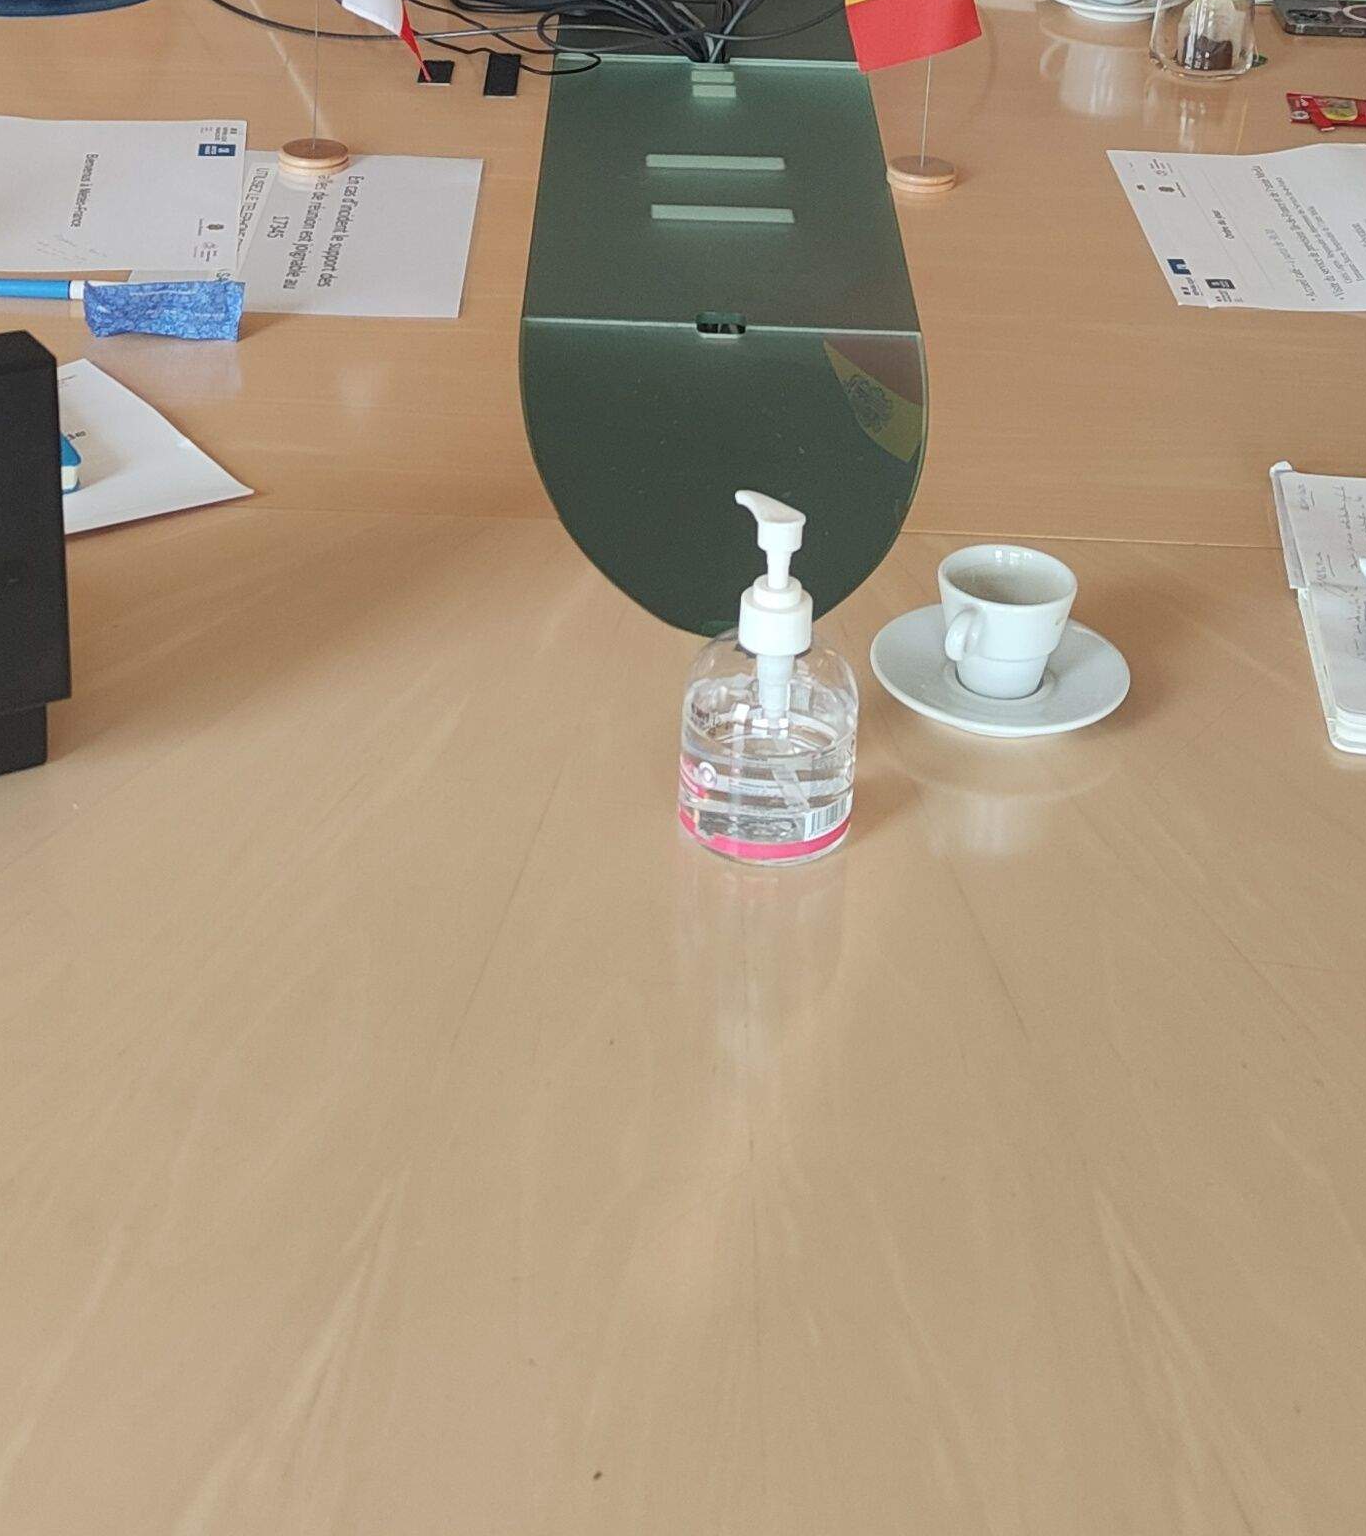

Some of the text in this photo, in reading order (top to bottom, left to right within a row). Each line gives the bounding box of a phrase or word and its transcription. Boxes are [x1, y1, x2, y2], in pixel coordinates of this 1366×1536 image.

[311, 191, 329, 200] de
[267, 216, 290, 239] 17345
[303, 202, 326, 230] réunion
[298, 230, 315, 242] est
[317, 176, 364, 288] En cas d'incident le support des
[286, 243, 314, 278] joignable
[283, 279, 299, 290] au
